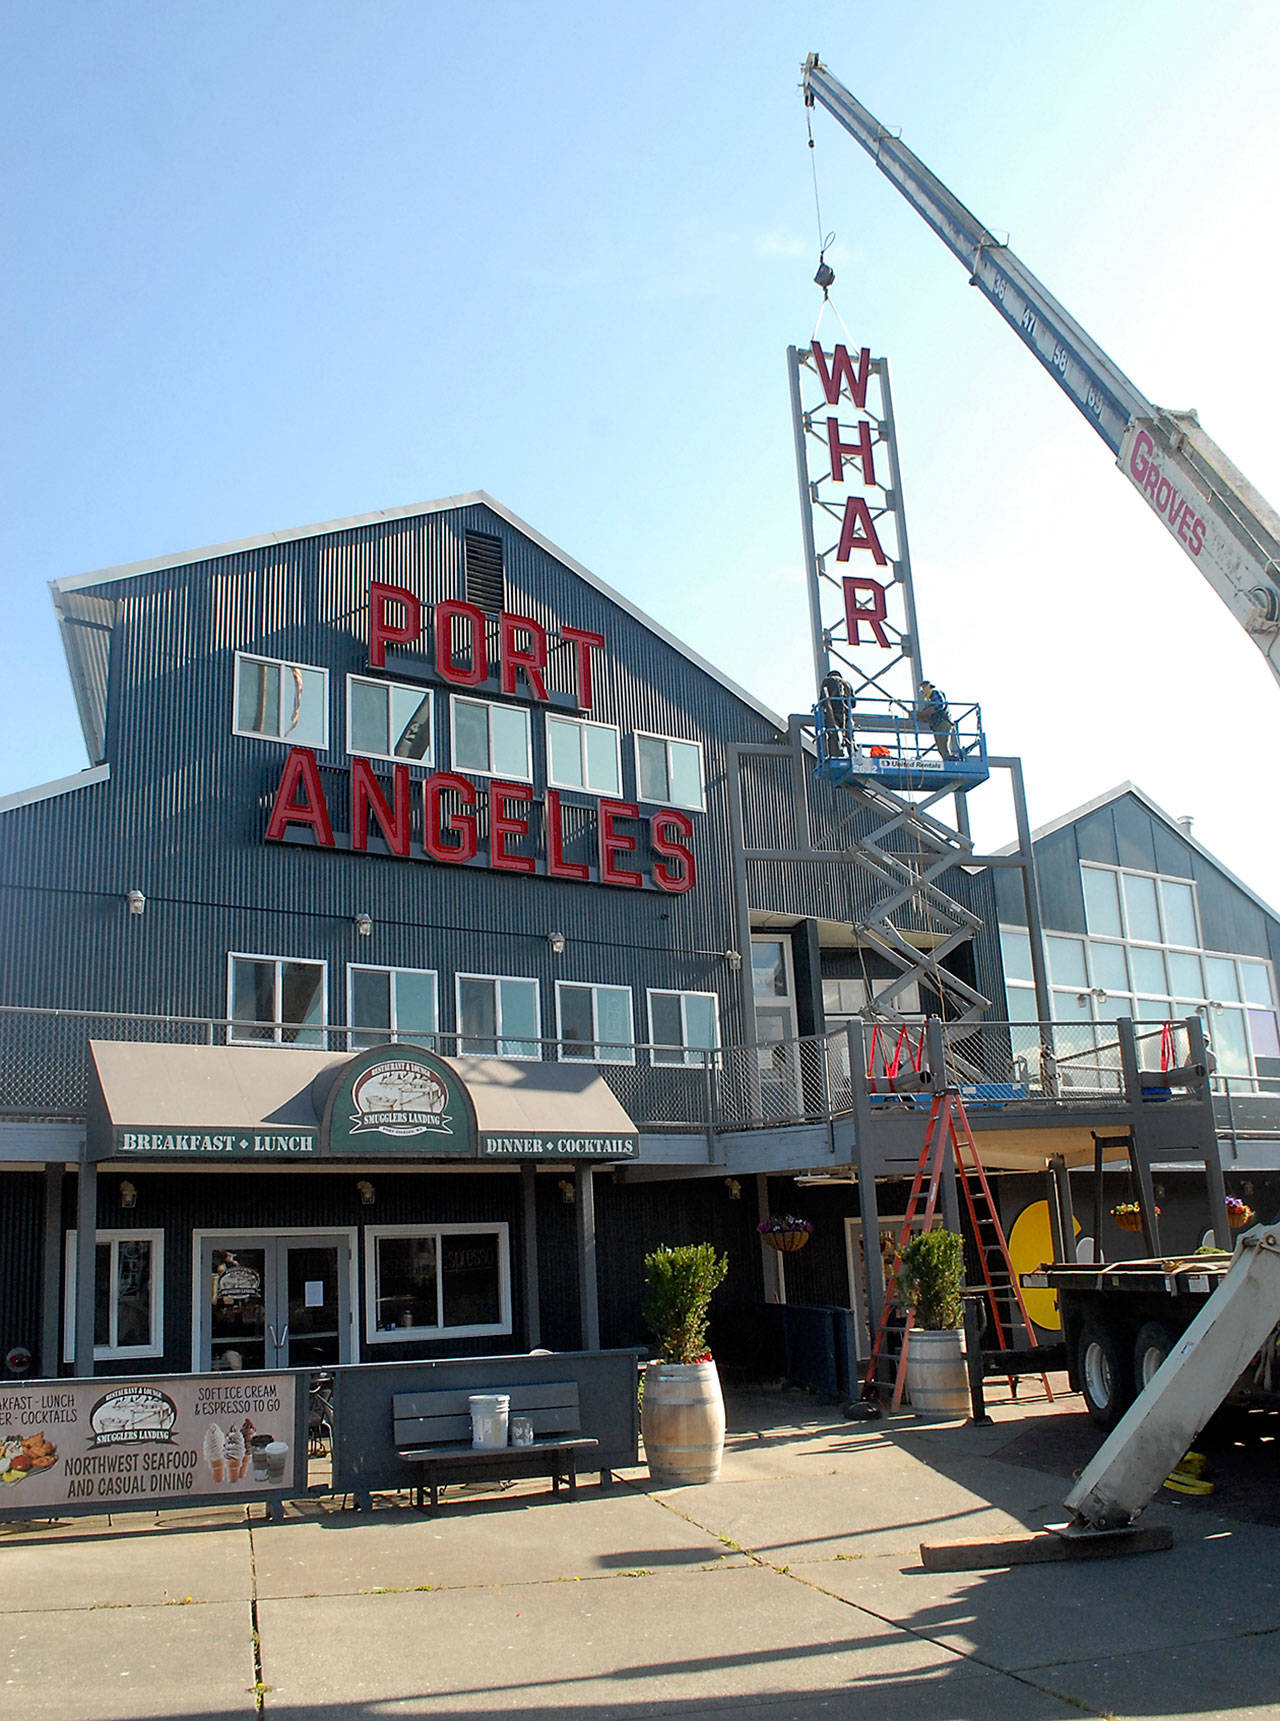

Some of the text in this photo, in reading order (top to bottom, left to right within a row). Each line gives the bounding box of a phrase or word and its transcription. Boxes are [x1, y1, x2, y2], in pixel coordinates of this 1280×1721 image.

[1022, 308, 1035, 333] 47
[1054, 344, 1068, 372] 58
[1130, 430, 1206, 556] GROVES
[369, 580, 605, 711] PORT
[916, 761, 941, 769] Rentals
[265, 747, 696, 894] ANGELES
[371, 1063, 405, 1076] RESTAURANT
[364, 1112, 440, 1125] SMUGGLERS LANDING
[123, 1134, 313, 1151] BREAKFAST LUNCH
[486, 1138, 633, 1153] DINNER COCKTAILS
[105, 1387, 137, 1400] RESTAURANT
[143, 1387, 162, 1398] LOUNGE
[198, 1385, 277, 1400] SOFT ICE CREAM
[0, 1396, 32, 1410] KFAST
[42, 1394, 74, 1408] LUNCH
[195, 1398, 280, 1415] & ESPRESSO TO GO
[21, 1408, 78, 1425] COCKTAILS
[96, 1430, 169, 1444] SMUGGLERS LANDING
[64, 1450, 198, 1477] NORTHWEST SEAFOOD
[67, 1472, 193, 1498] AND CASUAL DINING
